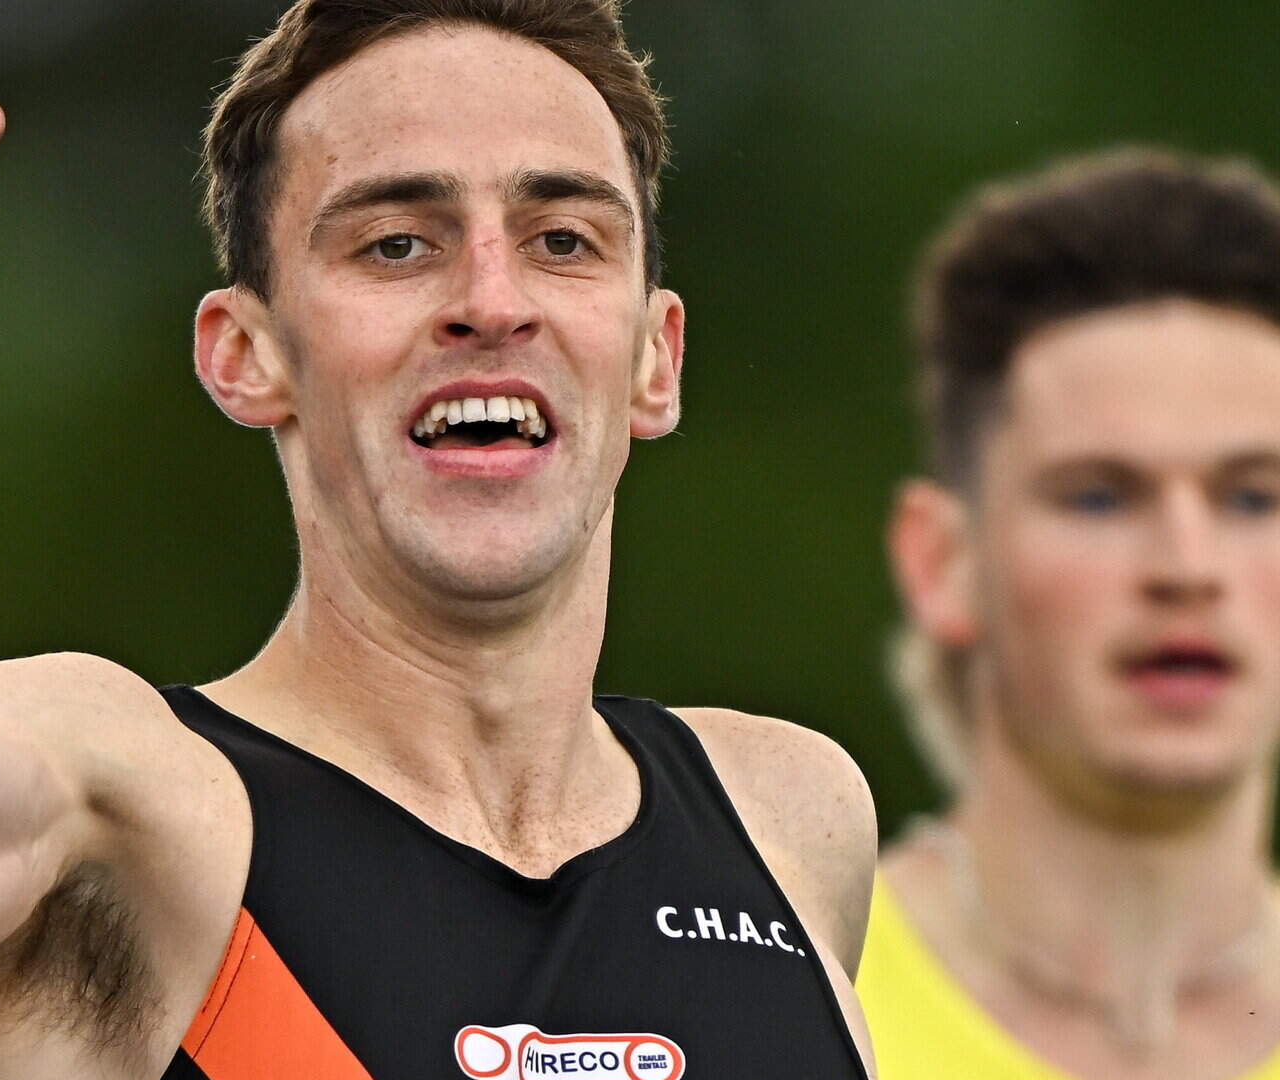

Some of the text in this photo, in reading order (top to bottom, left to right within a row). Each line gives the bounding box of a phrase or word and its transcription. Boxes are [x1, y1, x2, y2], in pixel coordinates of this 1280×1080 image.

[656, 906, 805, 956] C.H.A.C.
[525, 1046, 619, 1075] HIRECO
[638, 1054, 666, 1062] TRAILER
[638, 1062, 668, 1070] RENTALS
